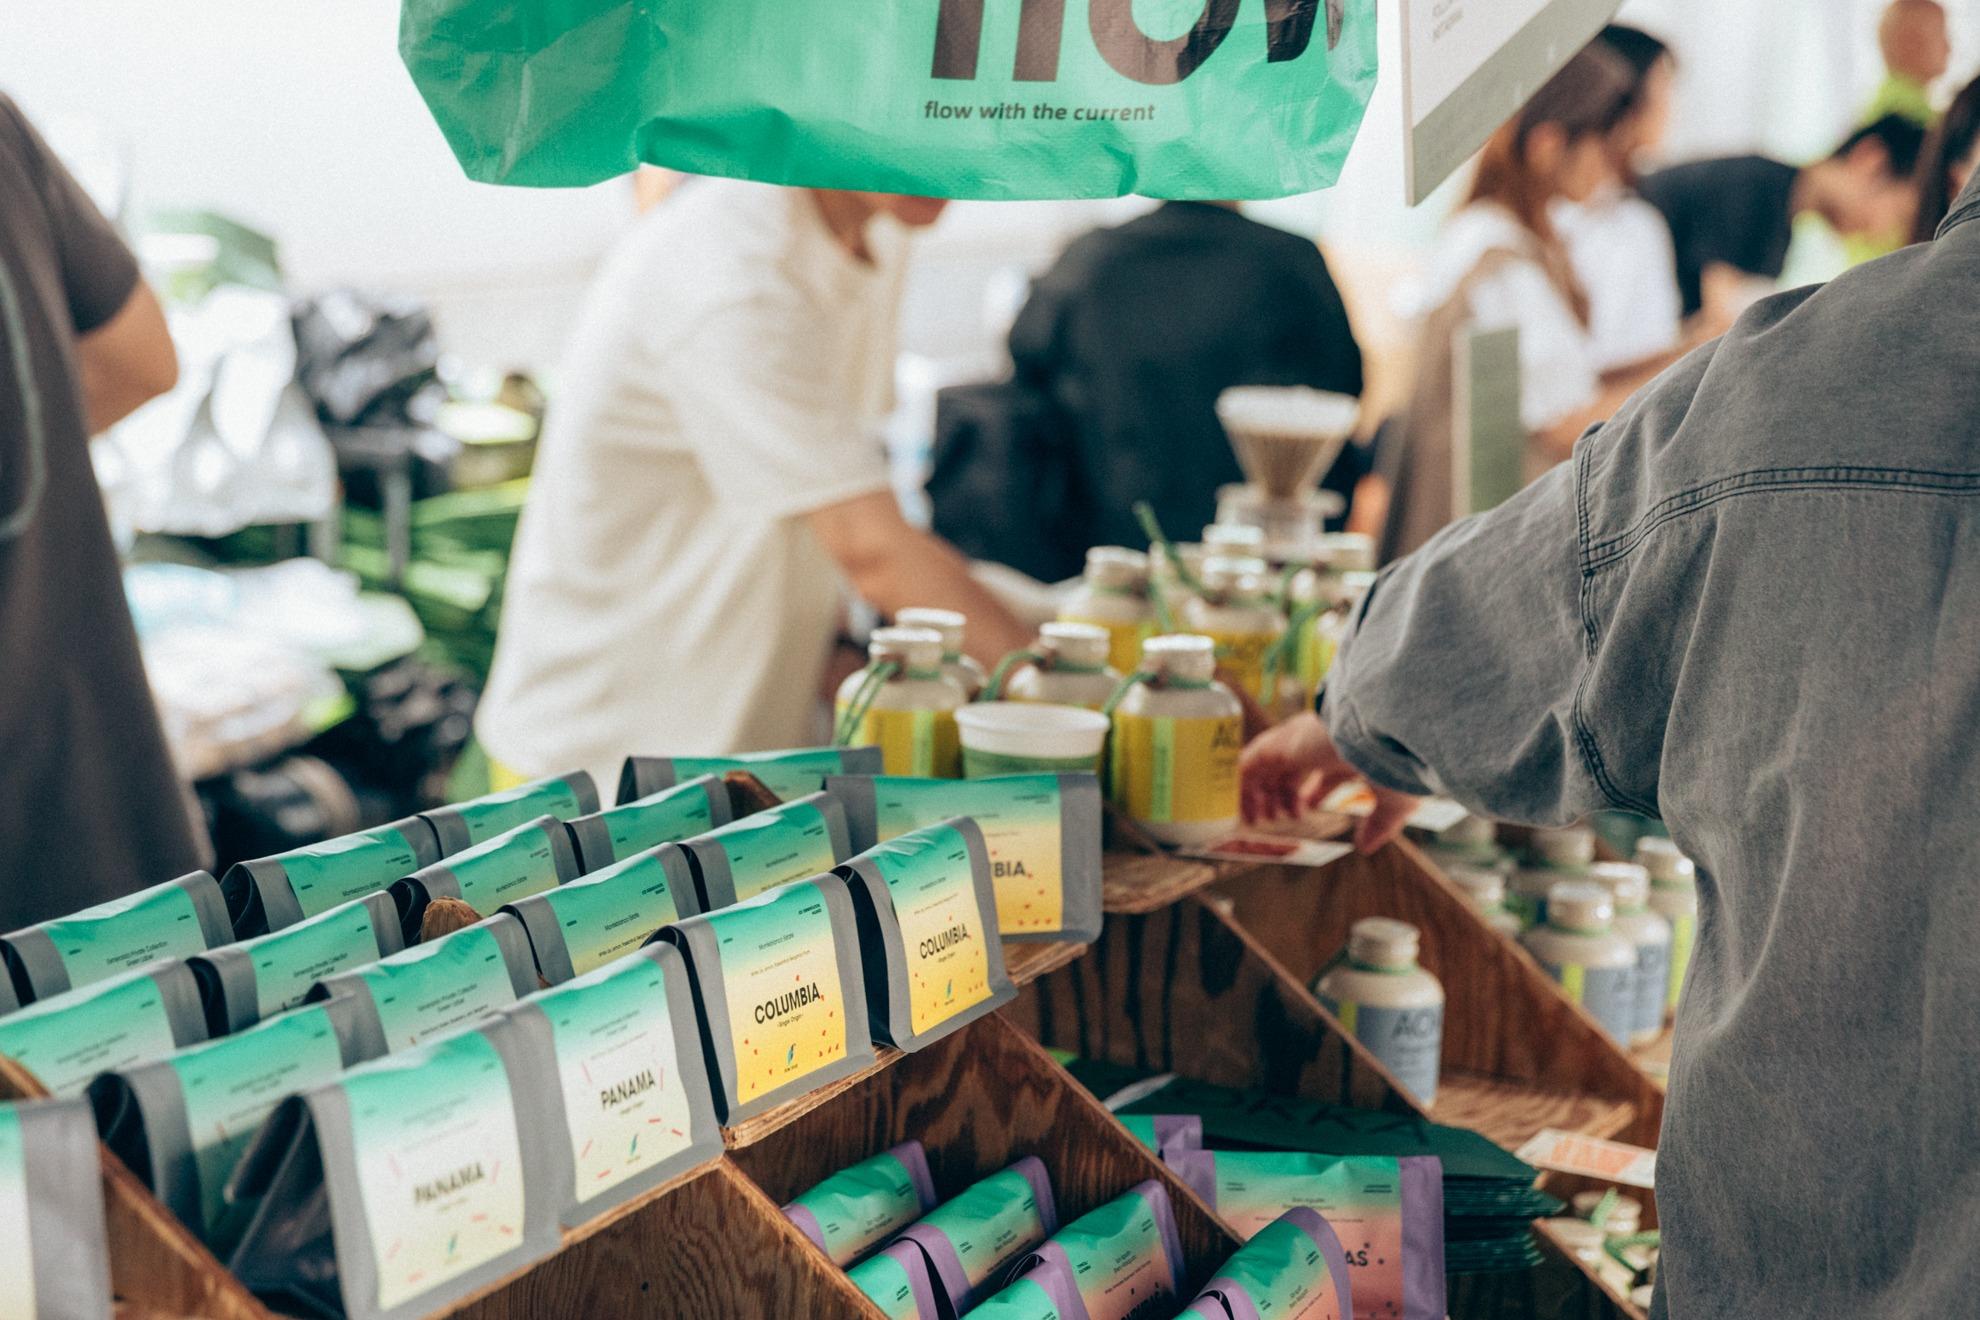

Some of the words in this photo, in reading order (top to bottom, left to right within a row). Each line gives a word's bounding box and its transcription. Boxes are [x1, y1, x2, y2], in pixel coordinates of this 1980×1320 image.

[925, 101, 972, 120] flow
[980, 102, 1026, 120] with
[1033, 103, 1068, 121] the
[1073, 104, 1156, 121] current
[920, 923, 969, 960] COLUMBIA
[754, 982, 821, 1025] COLUMBIA
[601, 1069, 656, 1110] PANAMA
[414, 1161, 485, 1204] PANAMA
